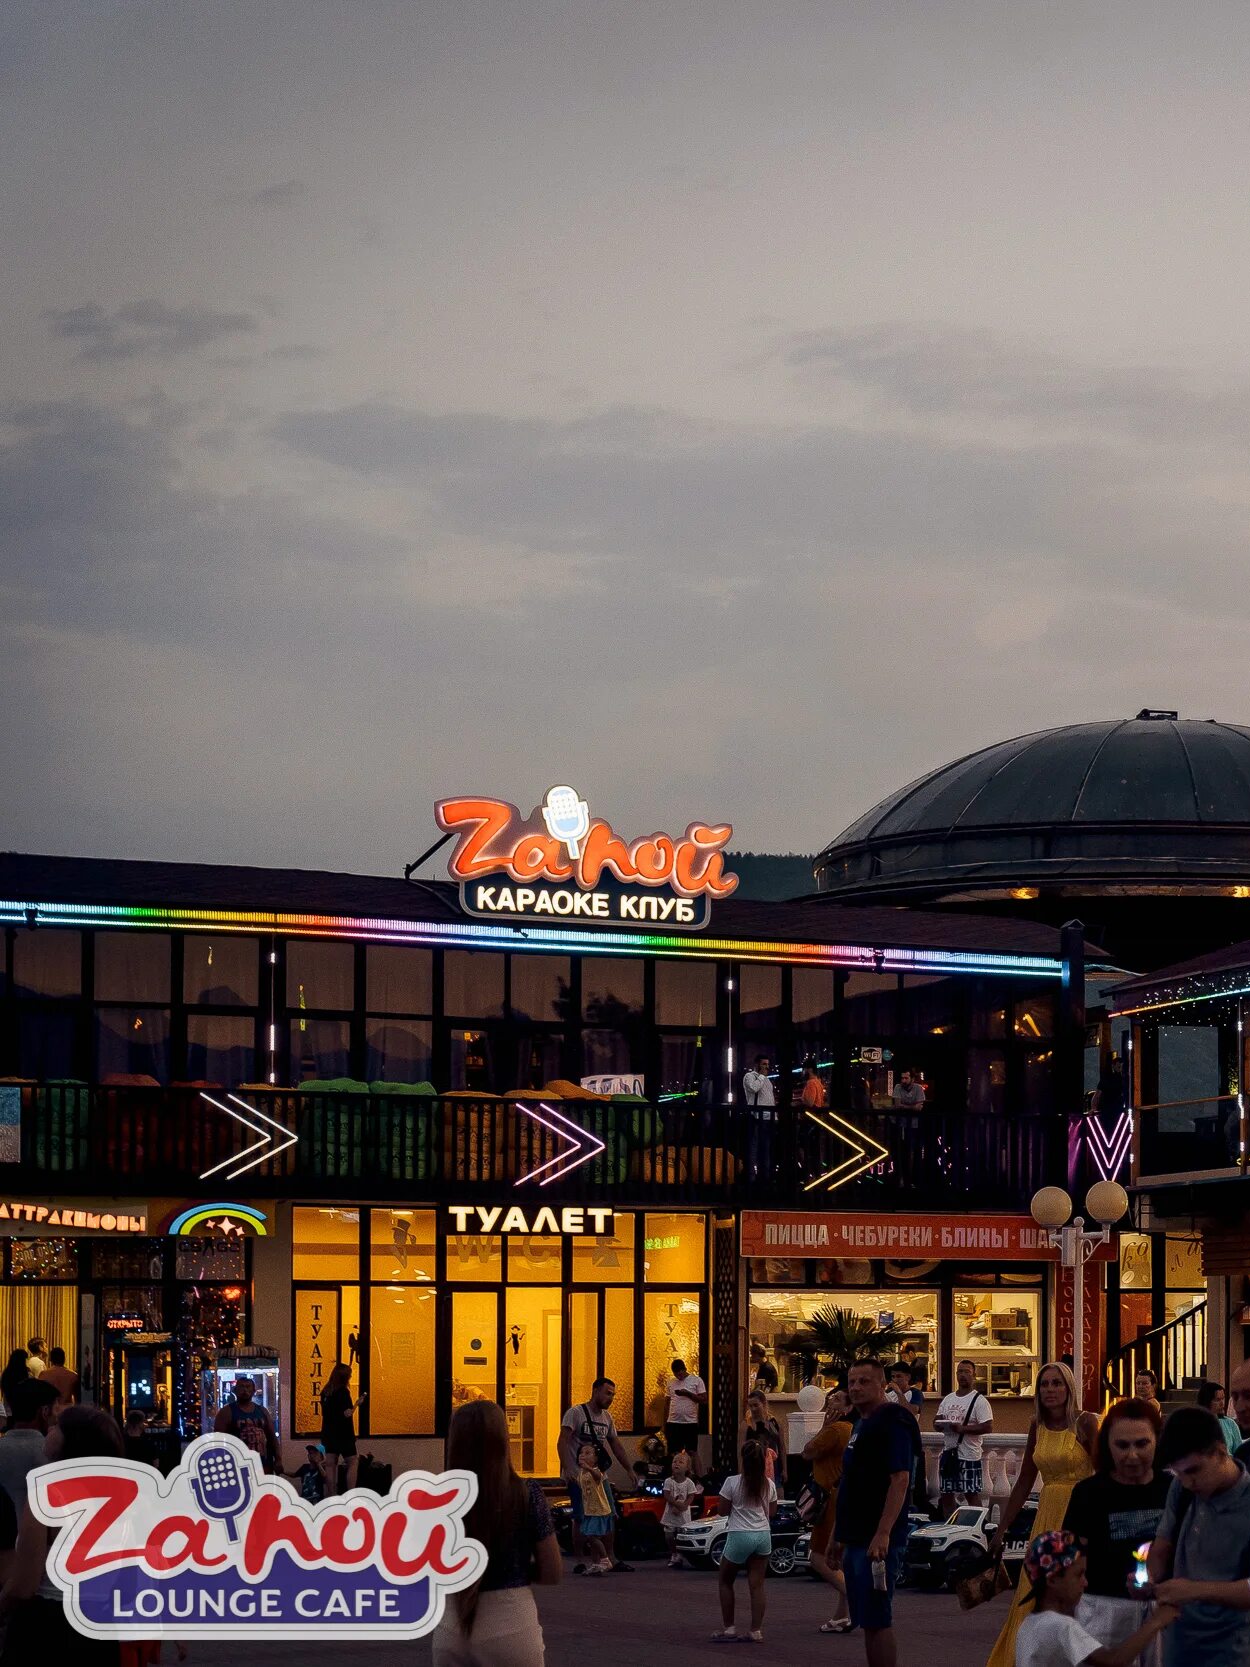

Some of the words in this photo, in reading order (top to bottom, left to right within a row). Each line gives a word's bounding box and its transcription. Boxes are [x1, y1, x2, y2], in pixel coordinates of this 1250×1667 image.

[477, 886, 609, 917] КАРАОКЕ
[620, 895, 695, 922] КЛУБ
[0, 1202, 146, 1231] АТТРАКЦИОНЫ
[448, 1206, 613, 1233] ТУАЛЕТ
[765, 1223, 830, 1249] ПИЦЦА
[842, 1225, 932, 1248] ЧЕБУРЕКИ
[941, 1227, 1009, 1249] БЛИНЫ
[107, 1318, 144, 1329] ОТКРЫТО
[664, 1303, 679, 1361] ТУА
[311, 1305, 323, 1416] ТУАЛЕТ
